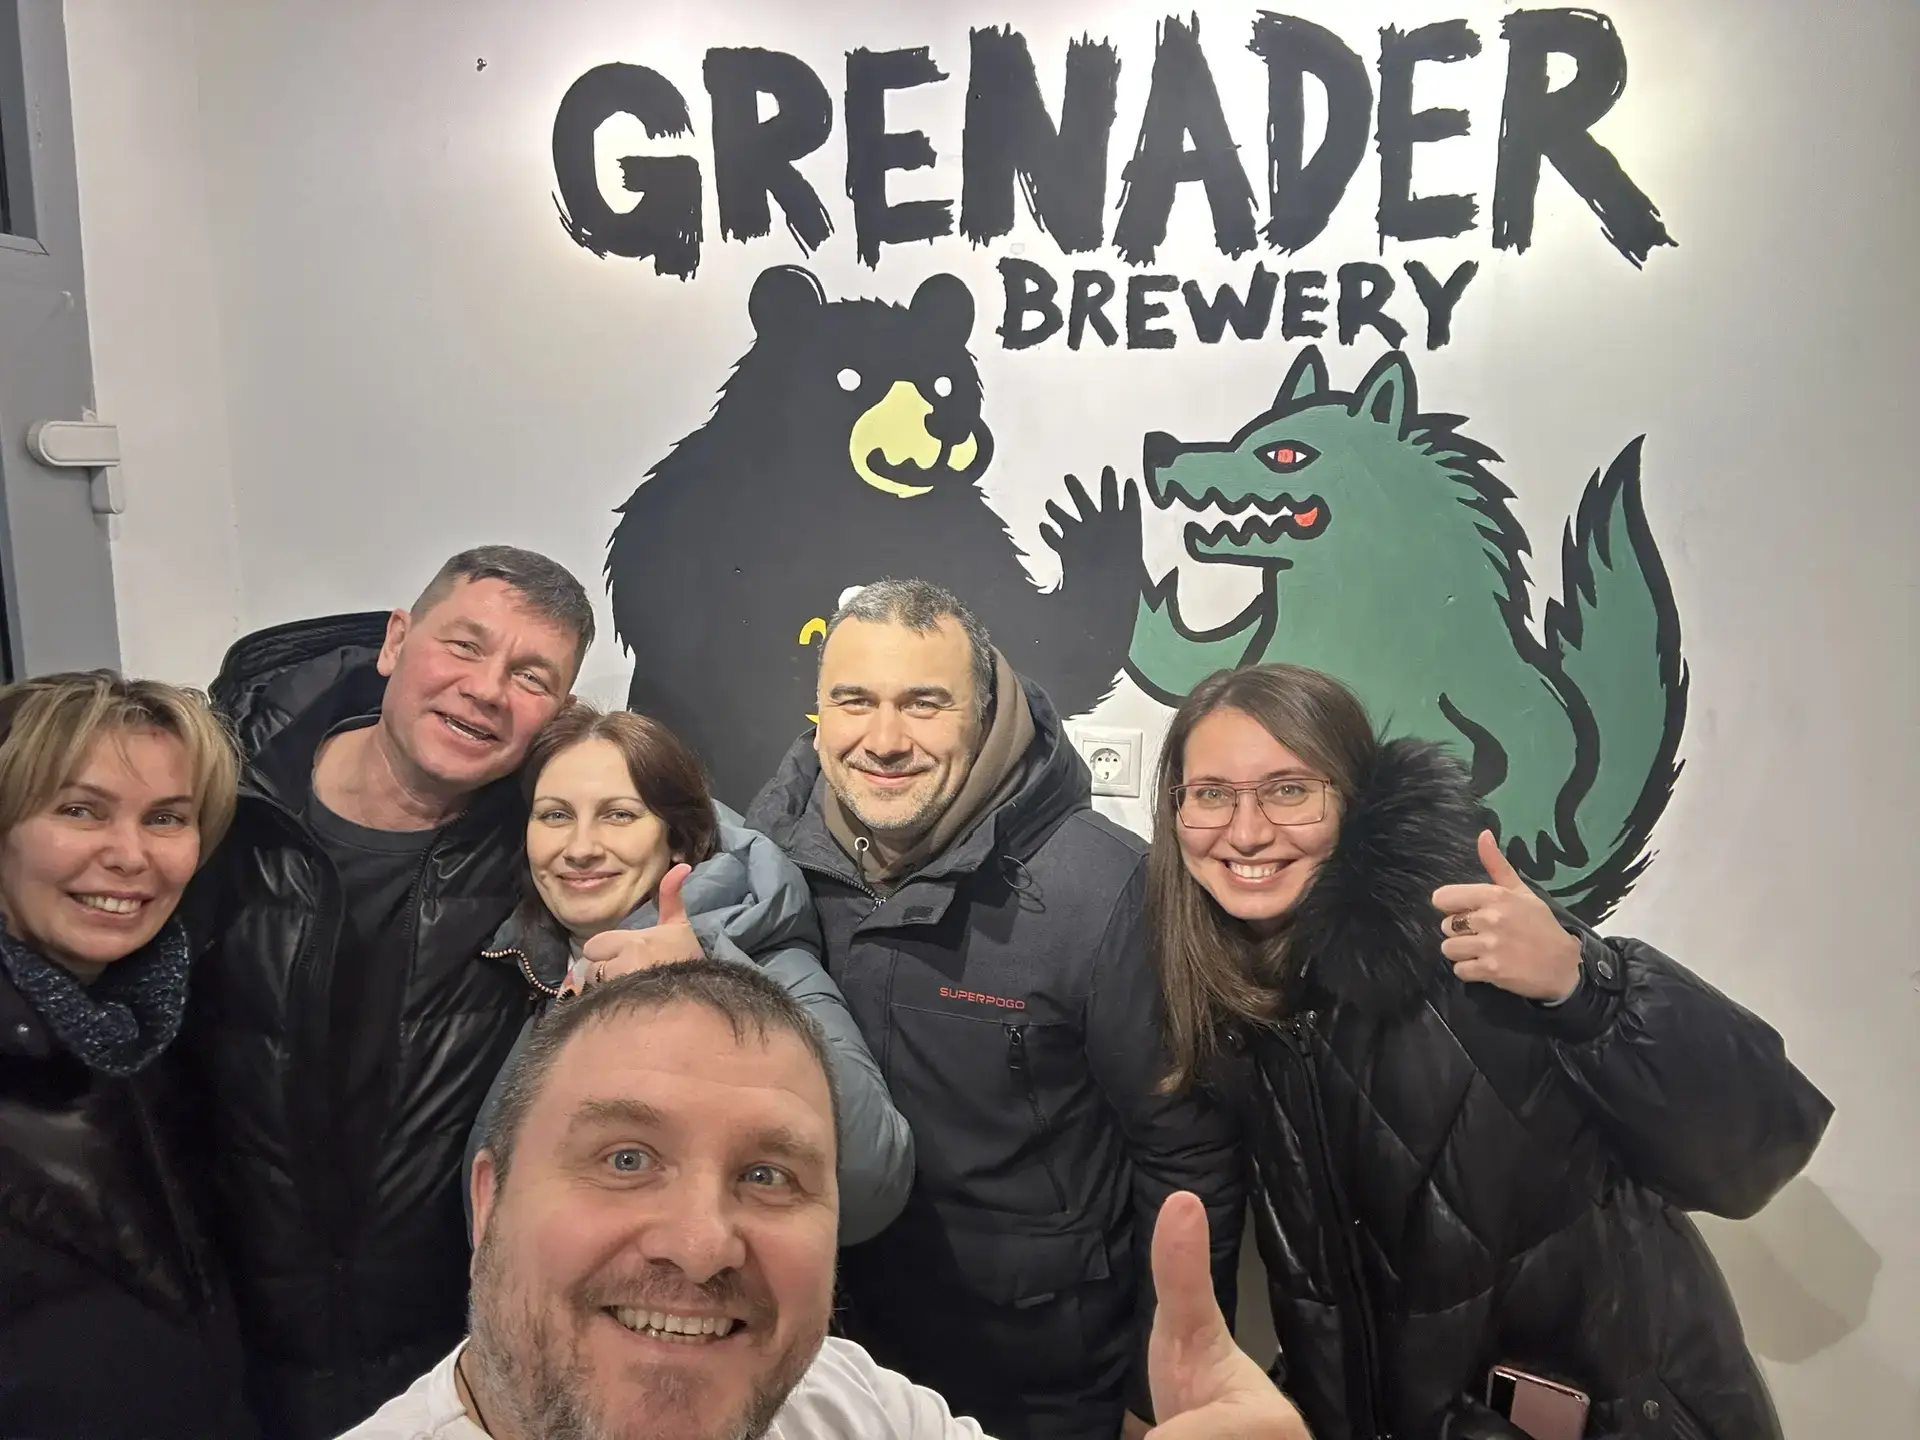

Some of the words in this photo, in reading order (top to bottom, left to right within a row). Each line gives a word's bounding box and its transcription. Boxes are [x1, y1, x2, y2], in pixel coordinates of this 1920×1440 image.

[551, 8, 1678, 281] GRENADER
[996, 257, 1479, 351] BREWERY
[939, 987, 1025, 1009] SUPERPOGO
